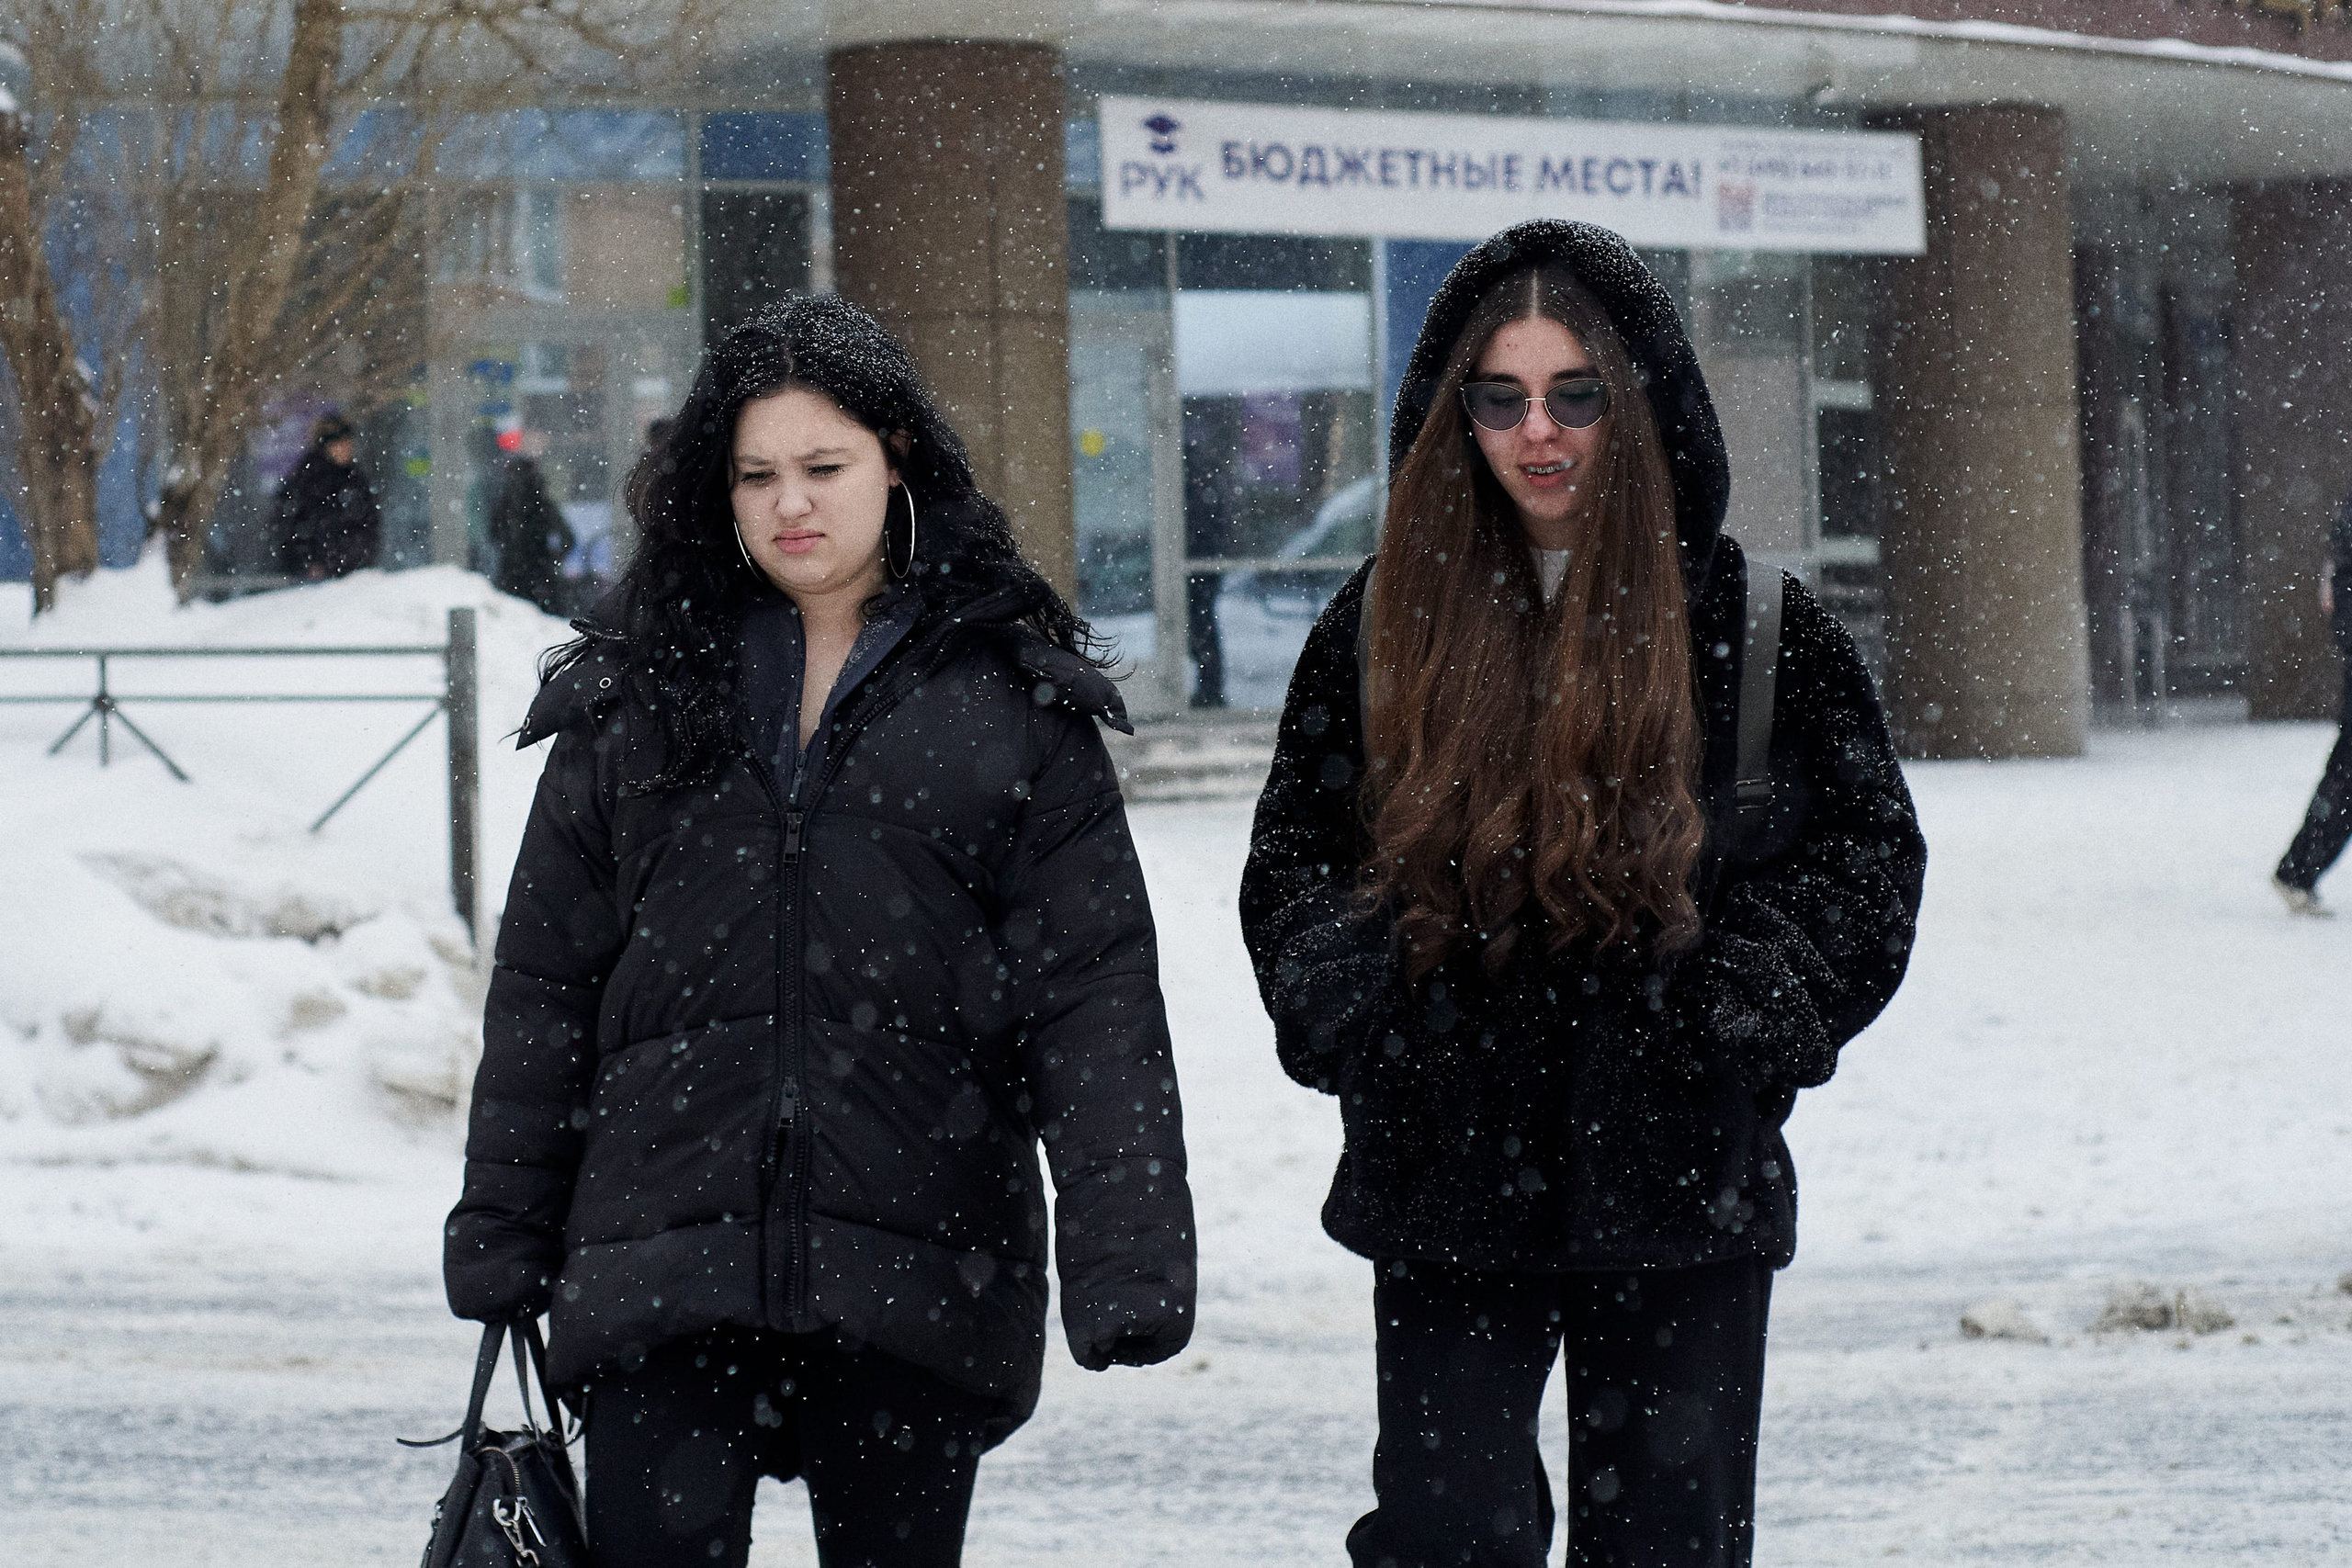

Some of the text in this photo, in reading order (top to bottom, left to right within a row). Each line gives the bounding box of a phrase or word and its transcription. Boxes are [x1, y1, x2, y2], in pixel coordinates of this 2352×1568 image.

[1119, 161, 1206, 200] РУК
[1220, 141, 1521, 191] БЮДЖЕТНЫЕ
[1537, 153, 1702, 197] МЕСТА!
